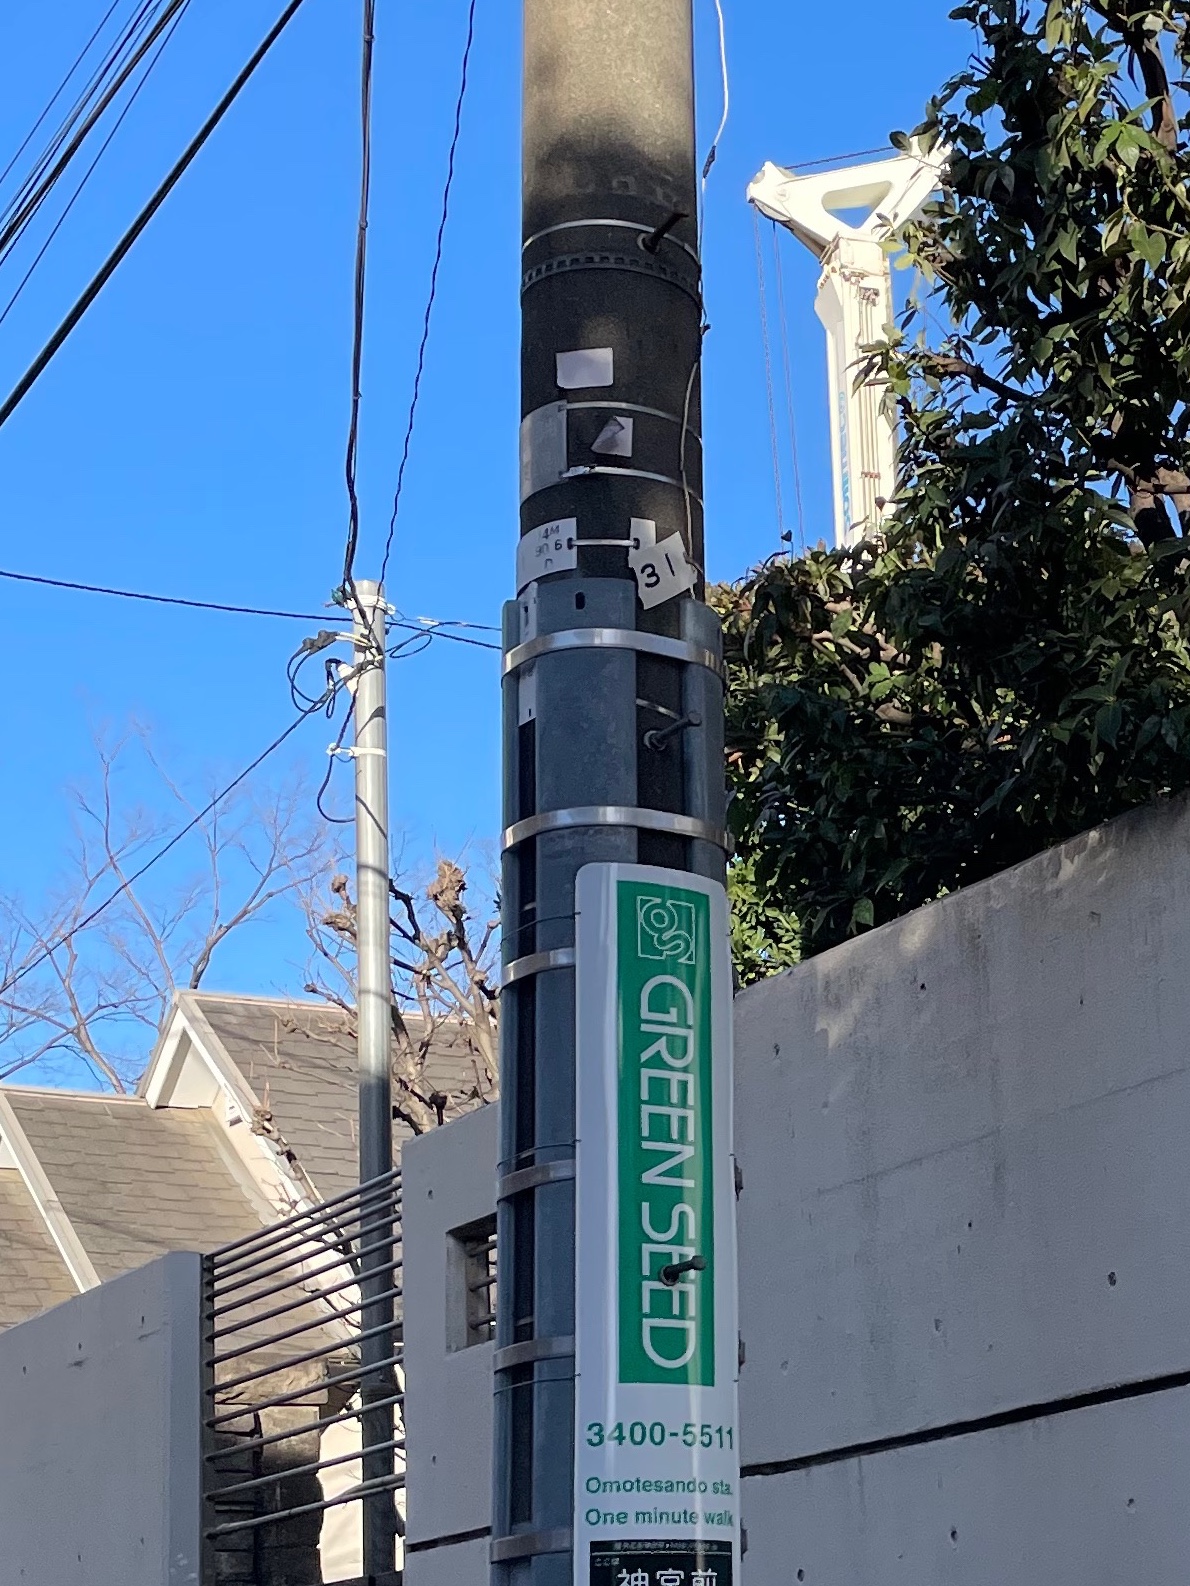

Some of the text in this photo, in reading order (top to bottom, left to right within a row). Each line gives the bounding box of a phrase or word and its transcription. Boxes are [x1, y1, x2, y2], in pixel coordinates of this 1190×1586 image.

[640, 974, 696, 1369] GREEN SEED
[586, 1421, 734, 1449] 3400-5511
[585, 1476, 708, 1494] Omotesando
[585, 1506, 734, 1527] One minute walk
